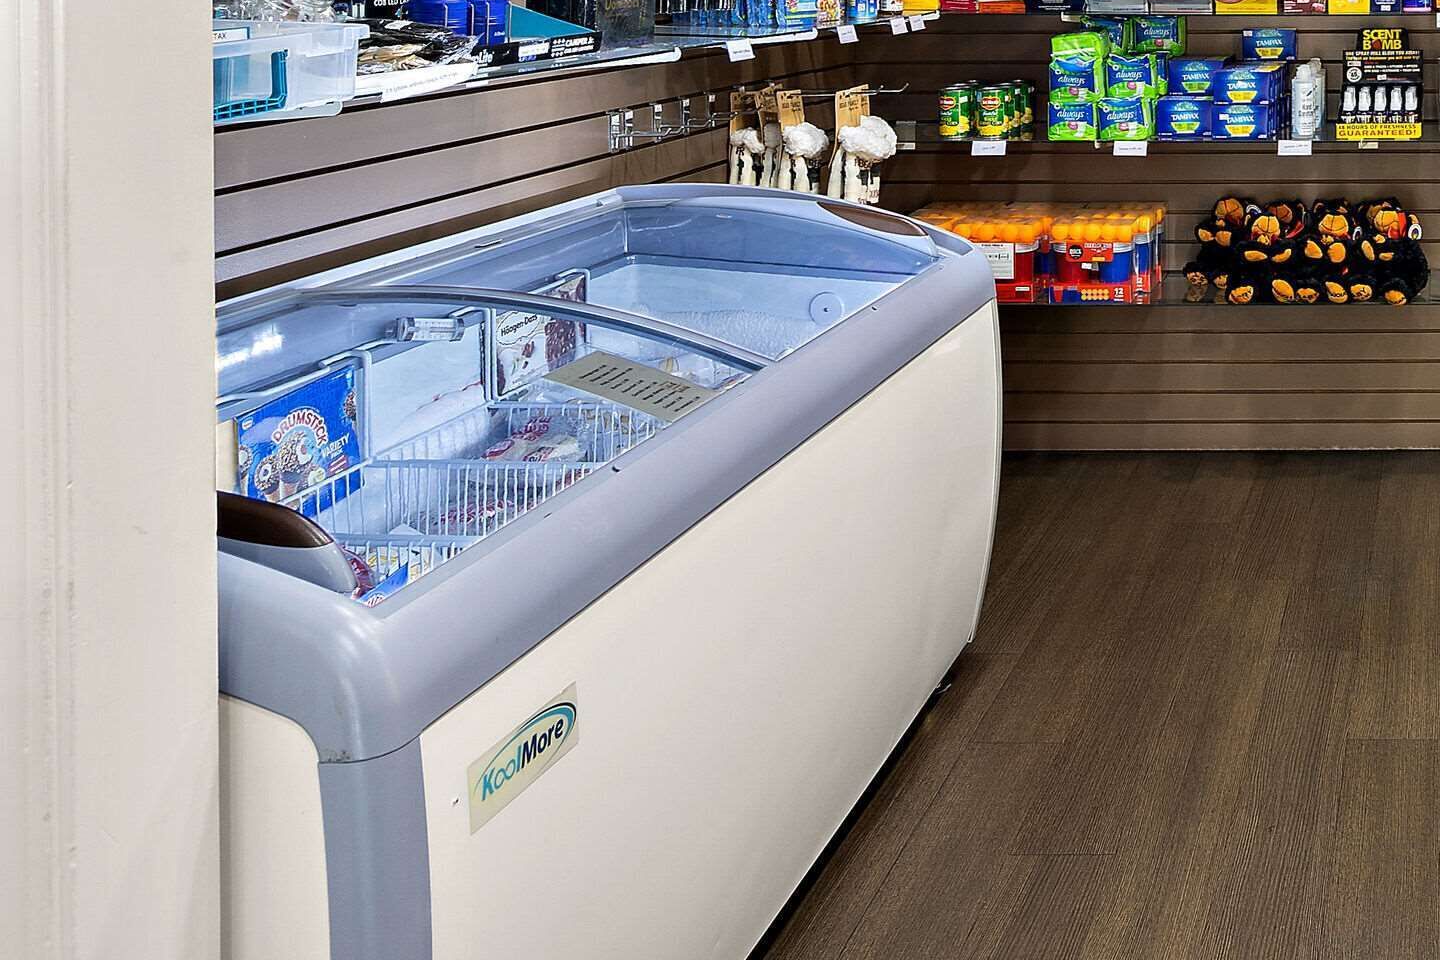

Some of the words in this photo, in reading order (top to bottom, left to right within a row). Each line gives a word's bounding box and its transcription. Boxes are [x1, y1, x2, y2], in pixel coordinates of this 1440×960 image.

[1143, 27, 1170, 36] always
[1362, 29, 1402, 40] SCENT
[1115, 70, 1143, 79] always
[1058, 76, 1086, 85] always
[1057, 110, 1085, 119] always
[1107, 113, 1135, 122] always
[1226, 115, 1255, 123] TAMPAX
[1339, 129, 1417, 137] GUARANTEED!
[272, 410, 328, 447] DRUMSTICK
[481, 718, 564, 802] KoolMore
